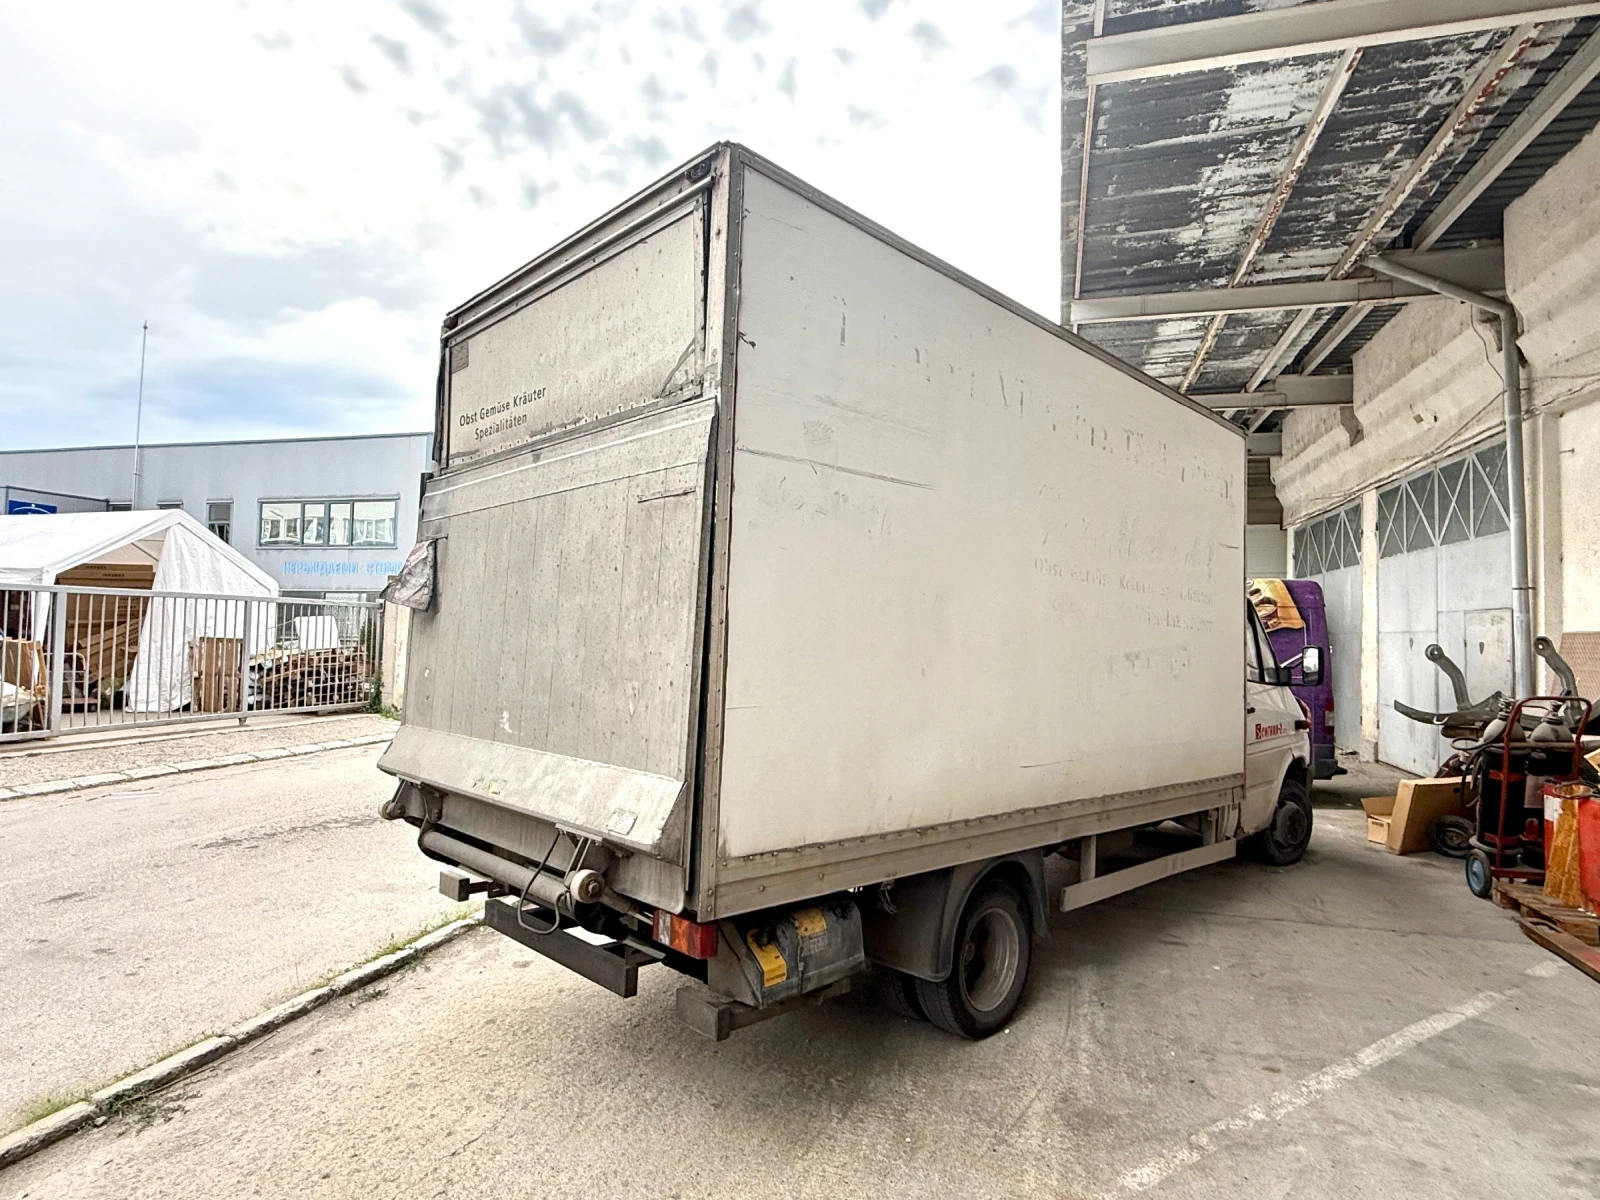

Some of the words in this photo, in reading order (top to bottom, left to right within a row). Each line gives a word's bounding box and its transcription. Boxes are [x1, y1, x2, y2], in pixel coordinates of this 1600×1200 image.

[459, 411, 478, 427] Obst
[479, 401, 511, 420] Gemüse
[513, 387, 546, 408] Kräuter
[474, 413, 528, 442] Spezialitäten
